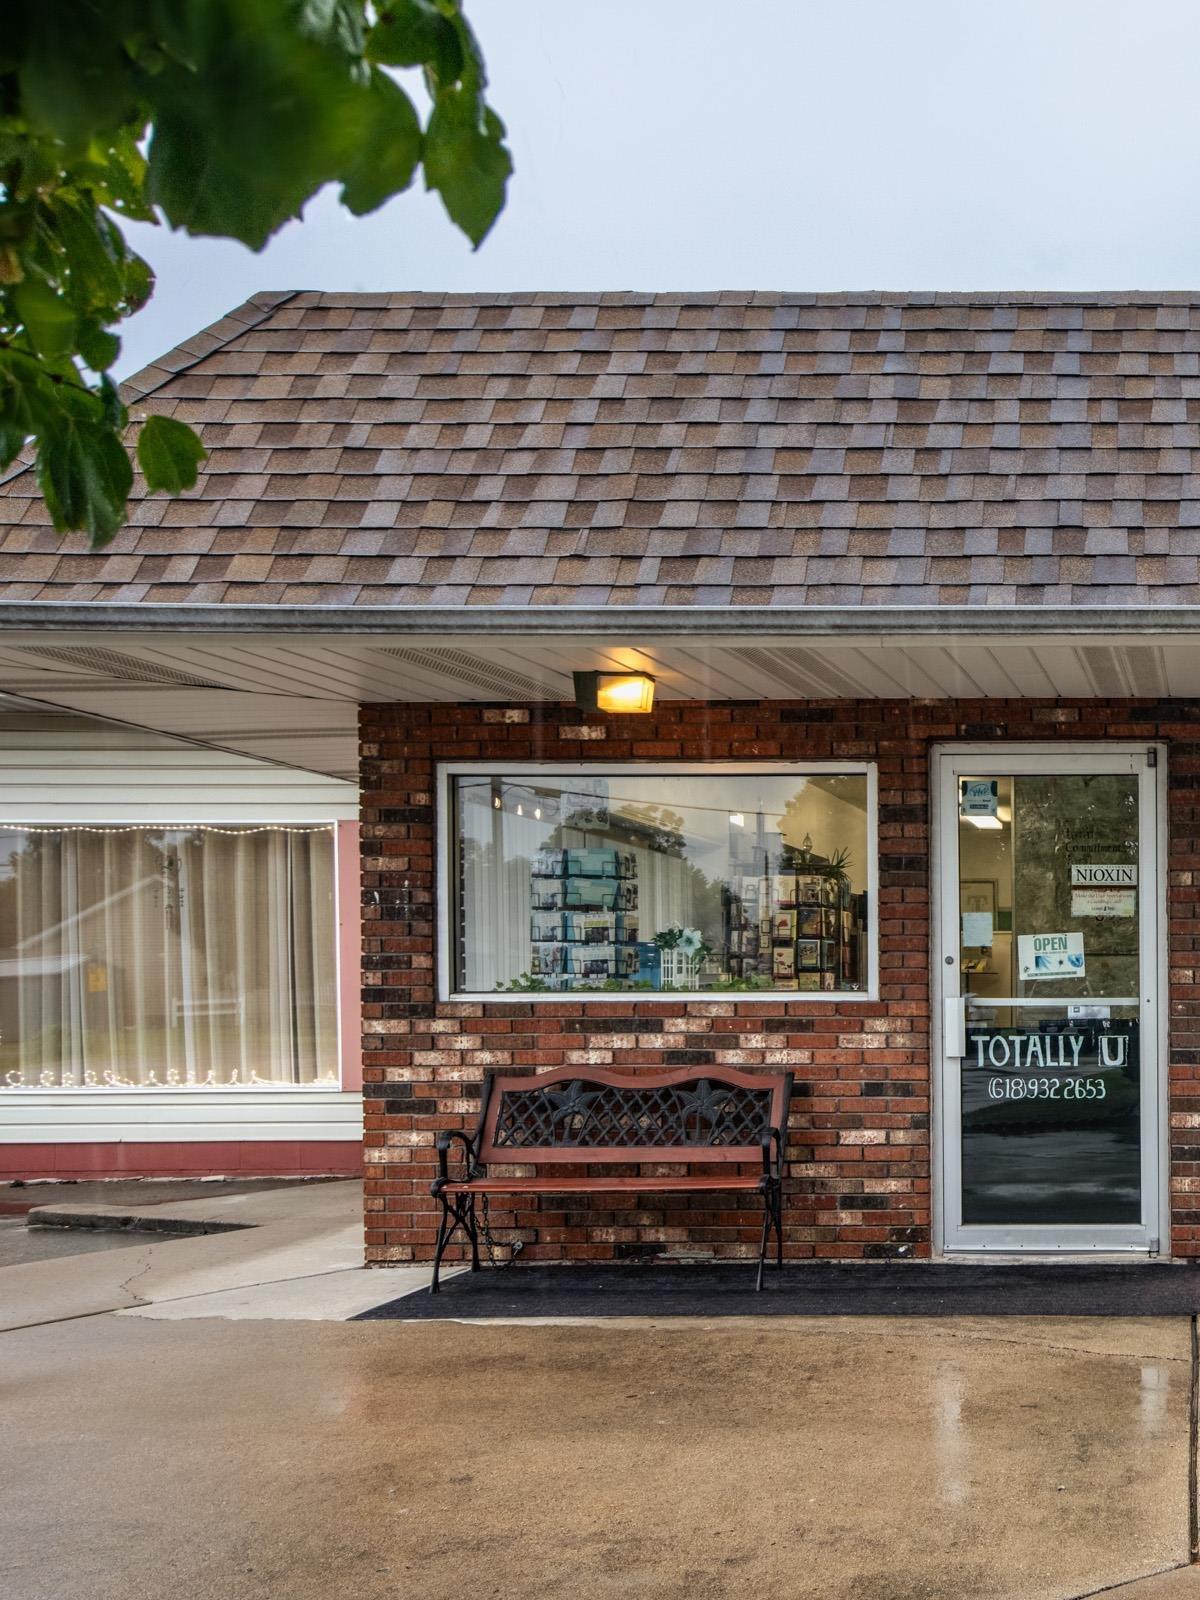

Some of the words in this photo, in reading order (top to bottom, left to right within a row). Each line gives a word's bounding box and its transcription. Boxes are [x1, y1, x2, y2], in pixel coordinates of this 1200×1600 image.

[1076, 868, 1133, 882] NIOXIN
[1033, 937, 1068, 952] OPEN
[970, 1035, 1084, 1067] TOTALLY
[1101, 1036, 1125, 1067] U
[988, 1077, 1061, 1099] (618)932
[1063, 1078, 1107, 1099] 2653
